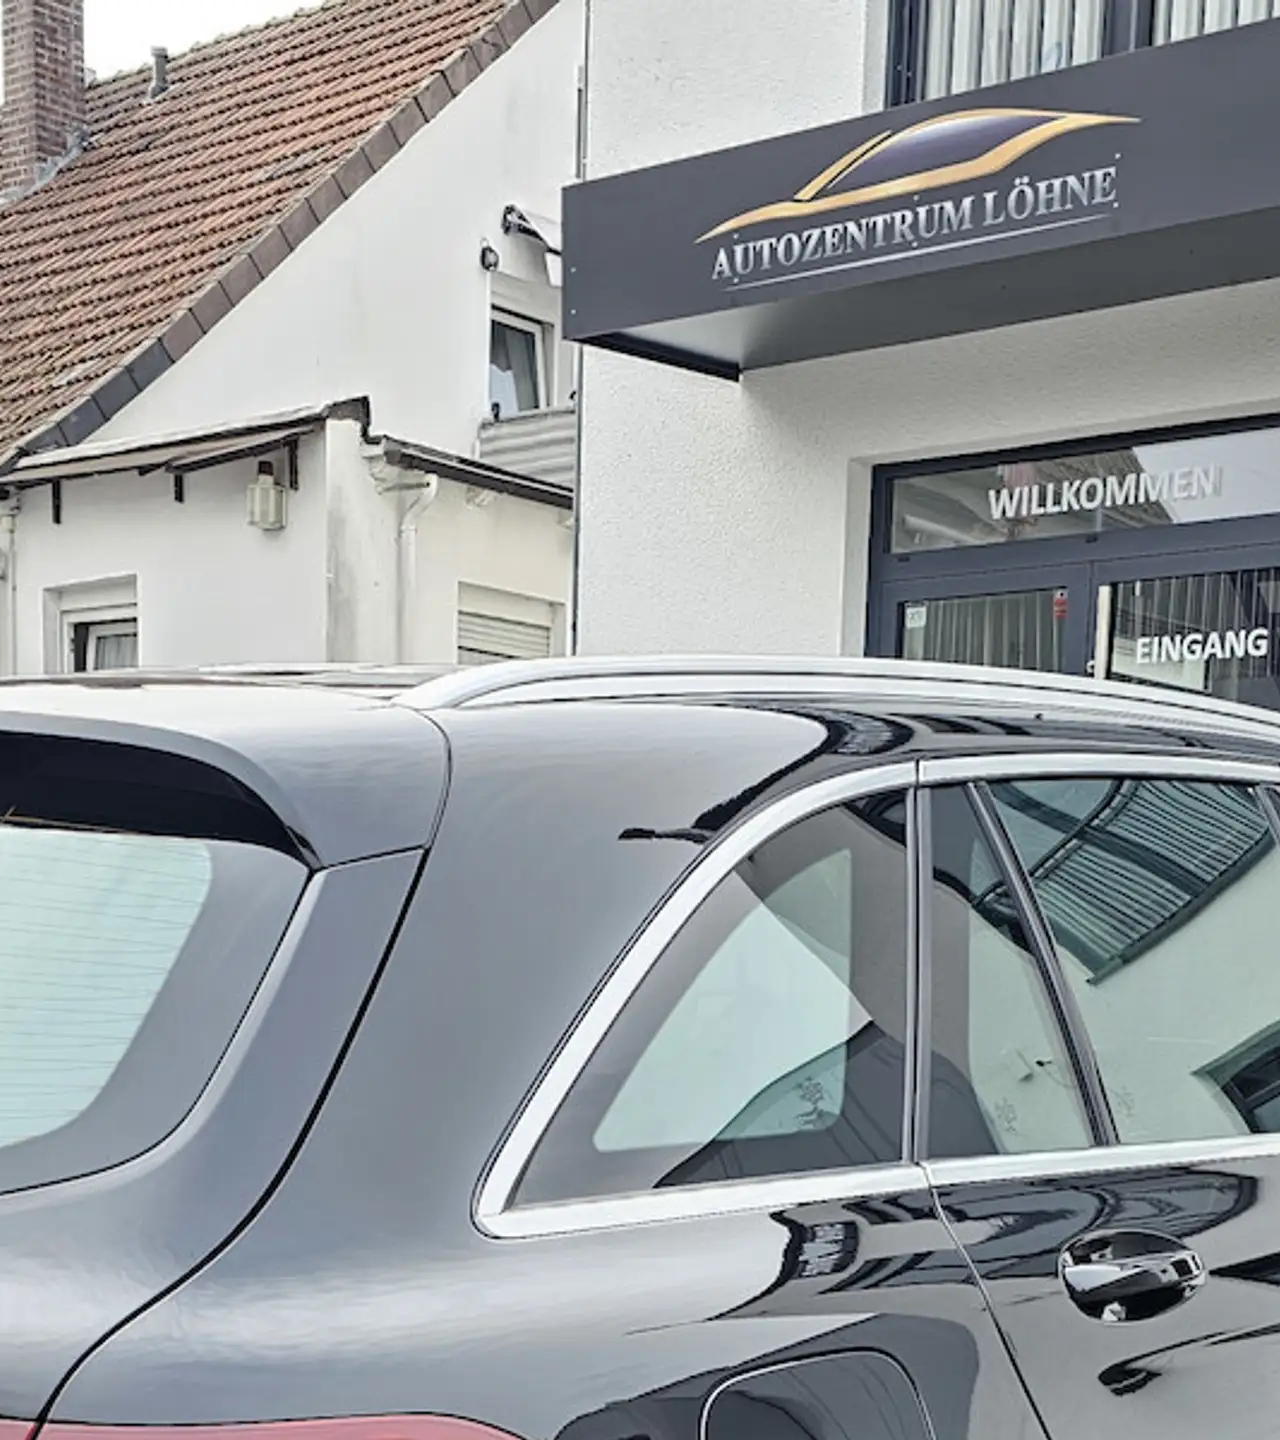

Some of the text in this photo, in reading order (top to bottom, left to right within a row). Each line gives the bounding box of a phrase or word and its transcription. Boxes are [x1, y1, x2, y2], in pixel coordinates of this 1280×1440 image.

[711, 165, 1118, 281] AUTOZENTRUM LÖHNE
[988, 463, 1221, 520] WILLKOMMEN
[1135, 627, 1269, 664] EINGANG
